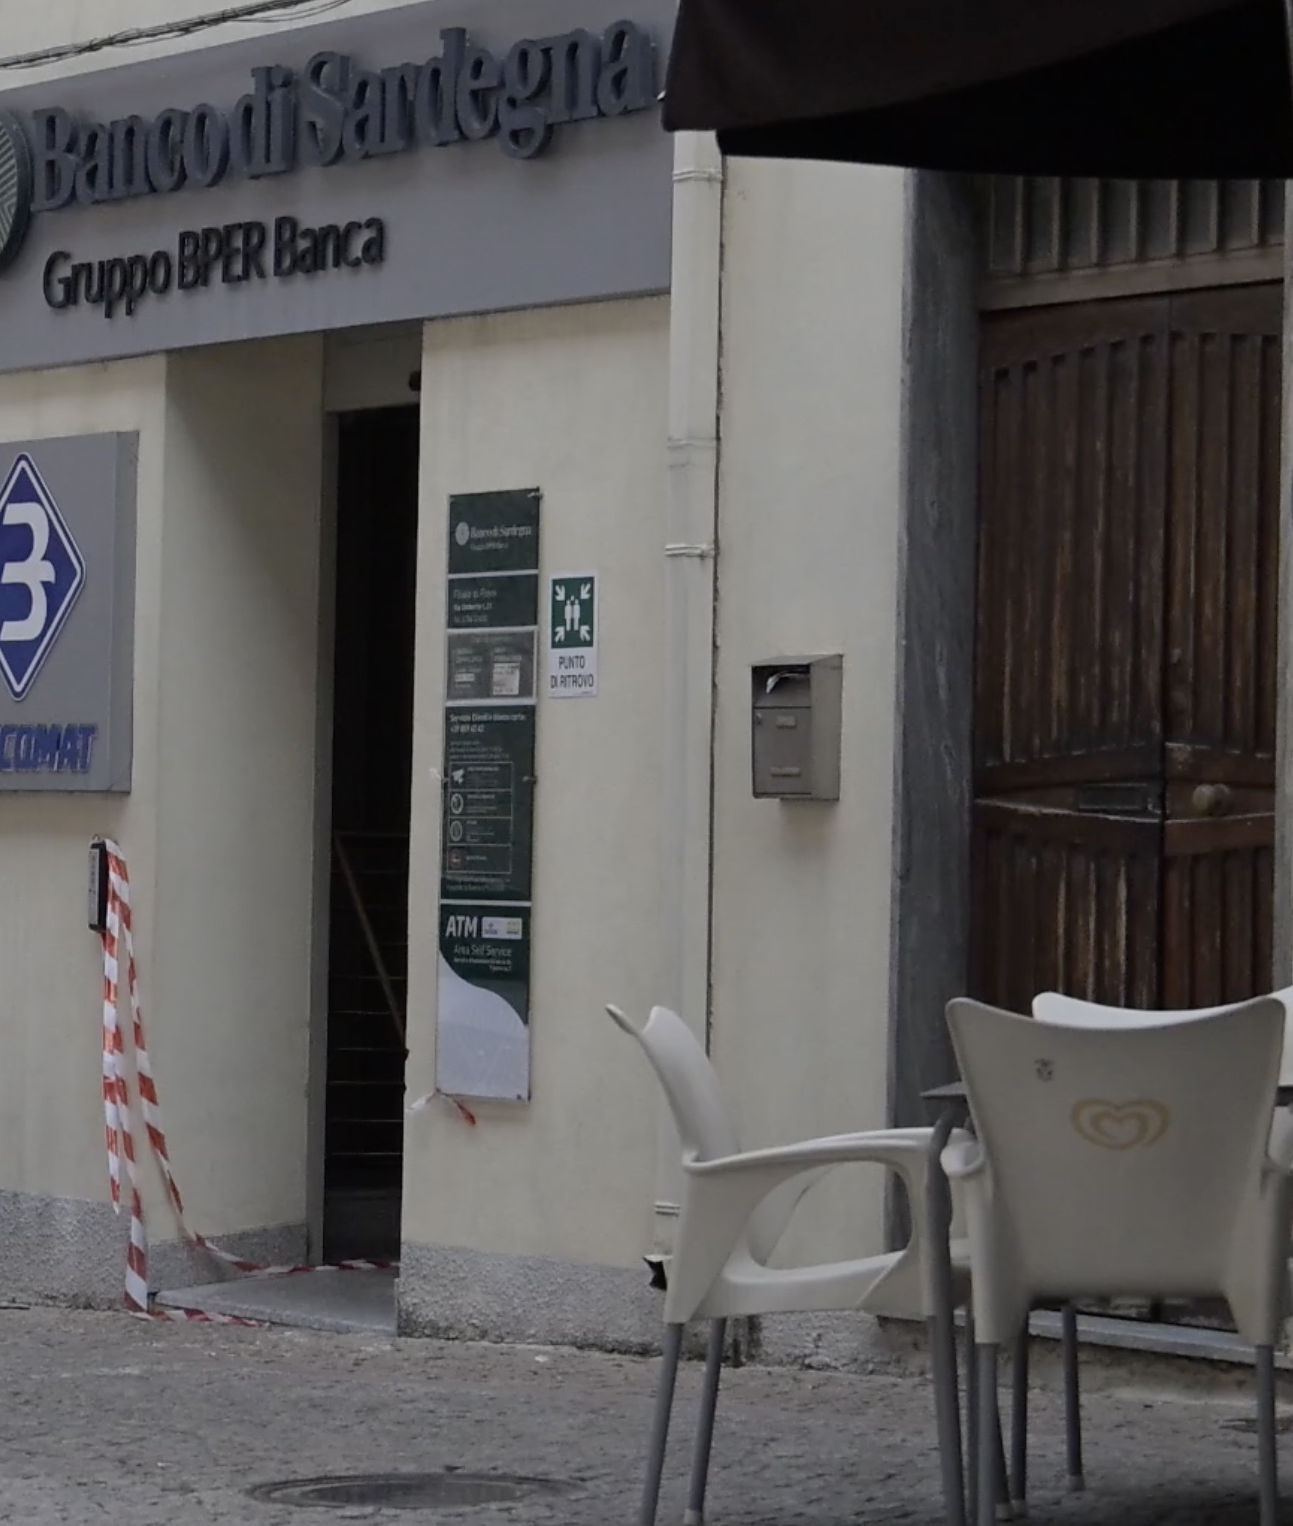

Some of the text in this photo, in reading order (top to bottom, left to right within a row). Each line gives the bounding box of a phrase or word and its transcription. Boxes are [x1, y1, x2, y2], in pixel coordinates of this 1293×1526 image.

[29, 20, 655, 213] Banco di Sardegna
[42, 216, 386, 319] Gruppo BPER Banca
[558, 655, 585, 670] PUNTO
[550, 673, 594, 689] DI RITROVO
[445, 915, 478, 939] ATM
